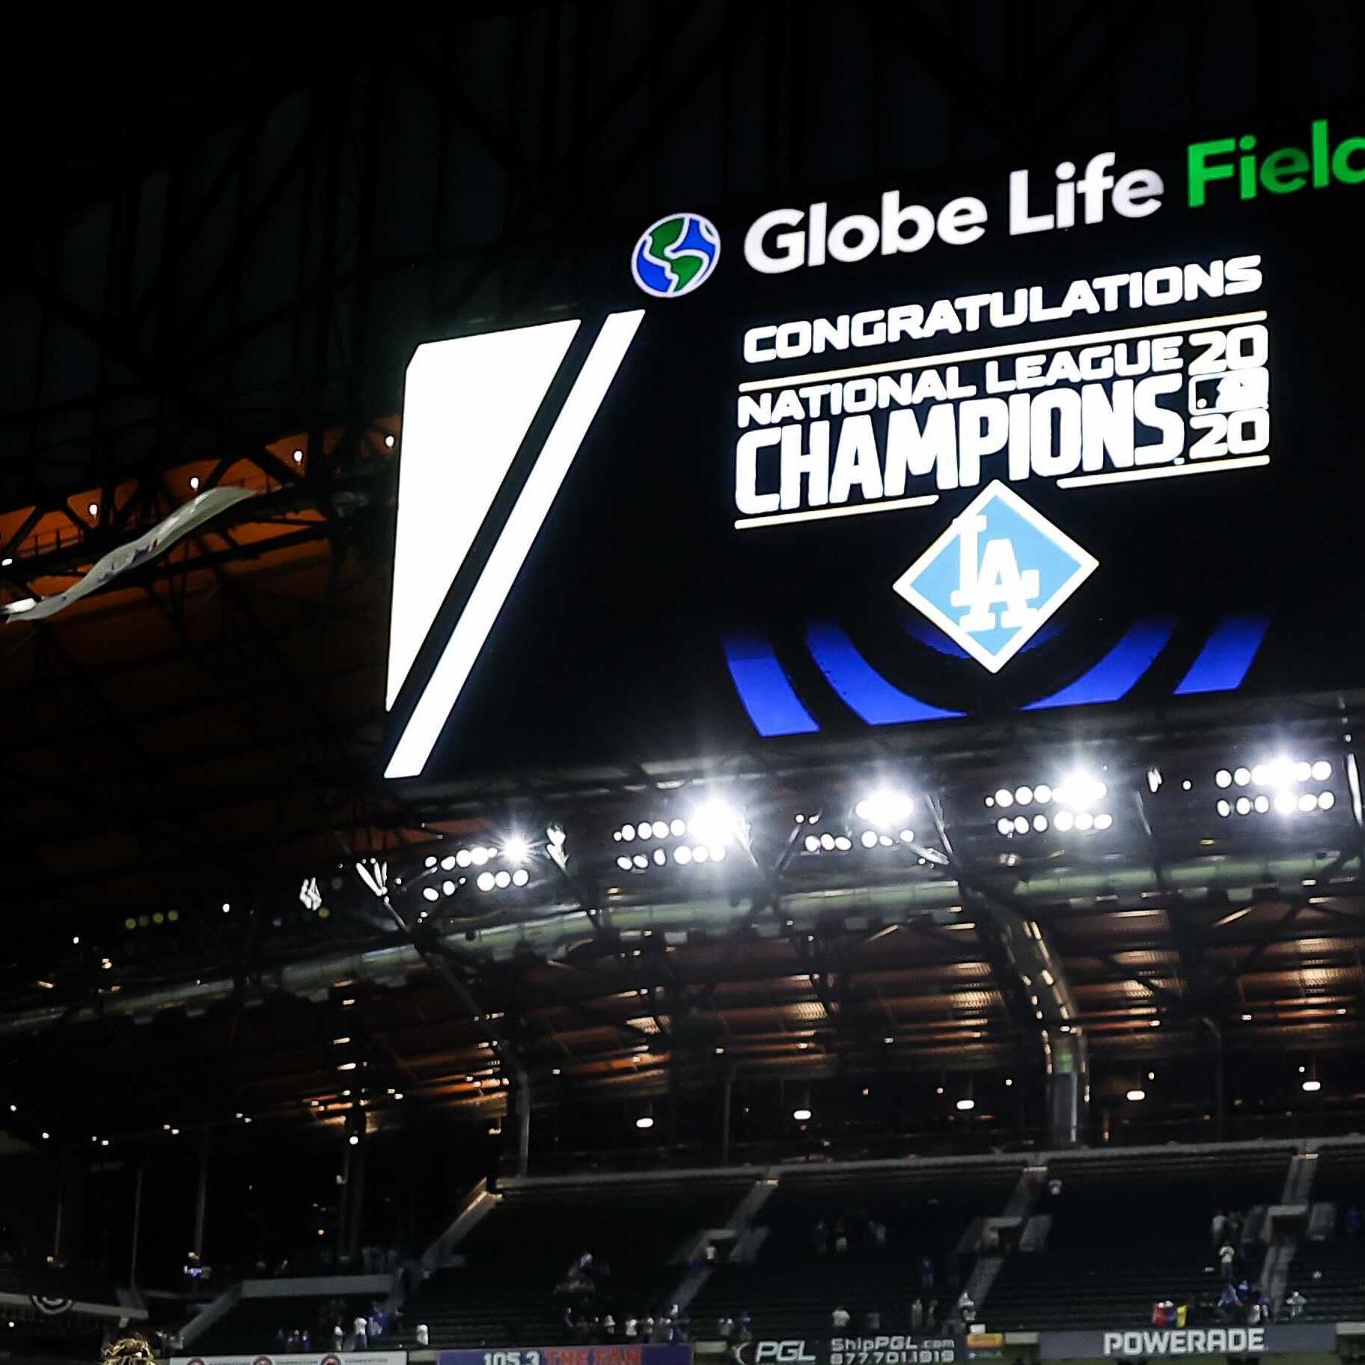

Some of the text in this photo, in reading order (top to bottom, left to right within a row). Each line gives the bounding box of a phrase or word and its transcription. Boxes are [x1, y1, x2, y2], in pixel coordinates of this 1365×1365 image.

[744, 189, 988, 275] Globe
[1008, 152, 1164, 236] Life
[744, 255, 1262, 364] CONGRATULATIONS
[1189, 325, 1268, 374] 20
[737, 335, 1183, 428] NATIONAL LEAGUE
[735, 375, 1186, 516] CHAMPIONS
[1190, 410, 1270, 460] 20
[951, 515, 1040, 632] LA
[756, 1341, 816, 1363] PGL
[1103, 1328, 1267, 1356] POWERADE
